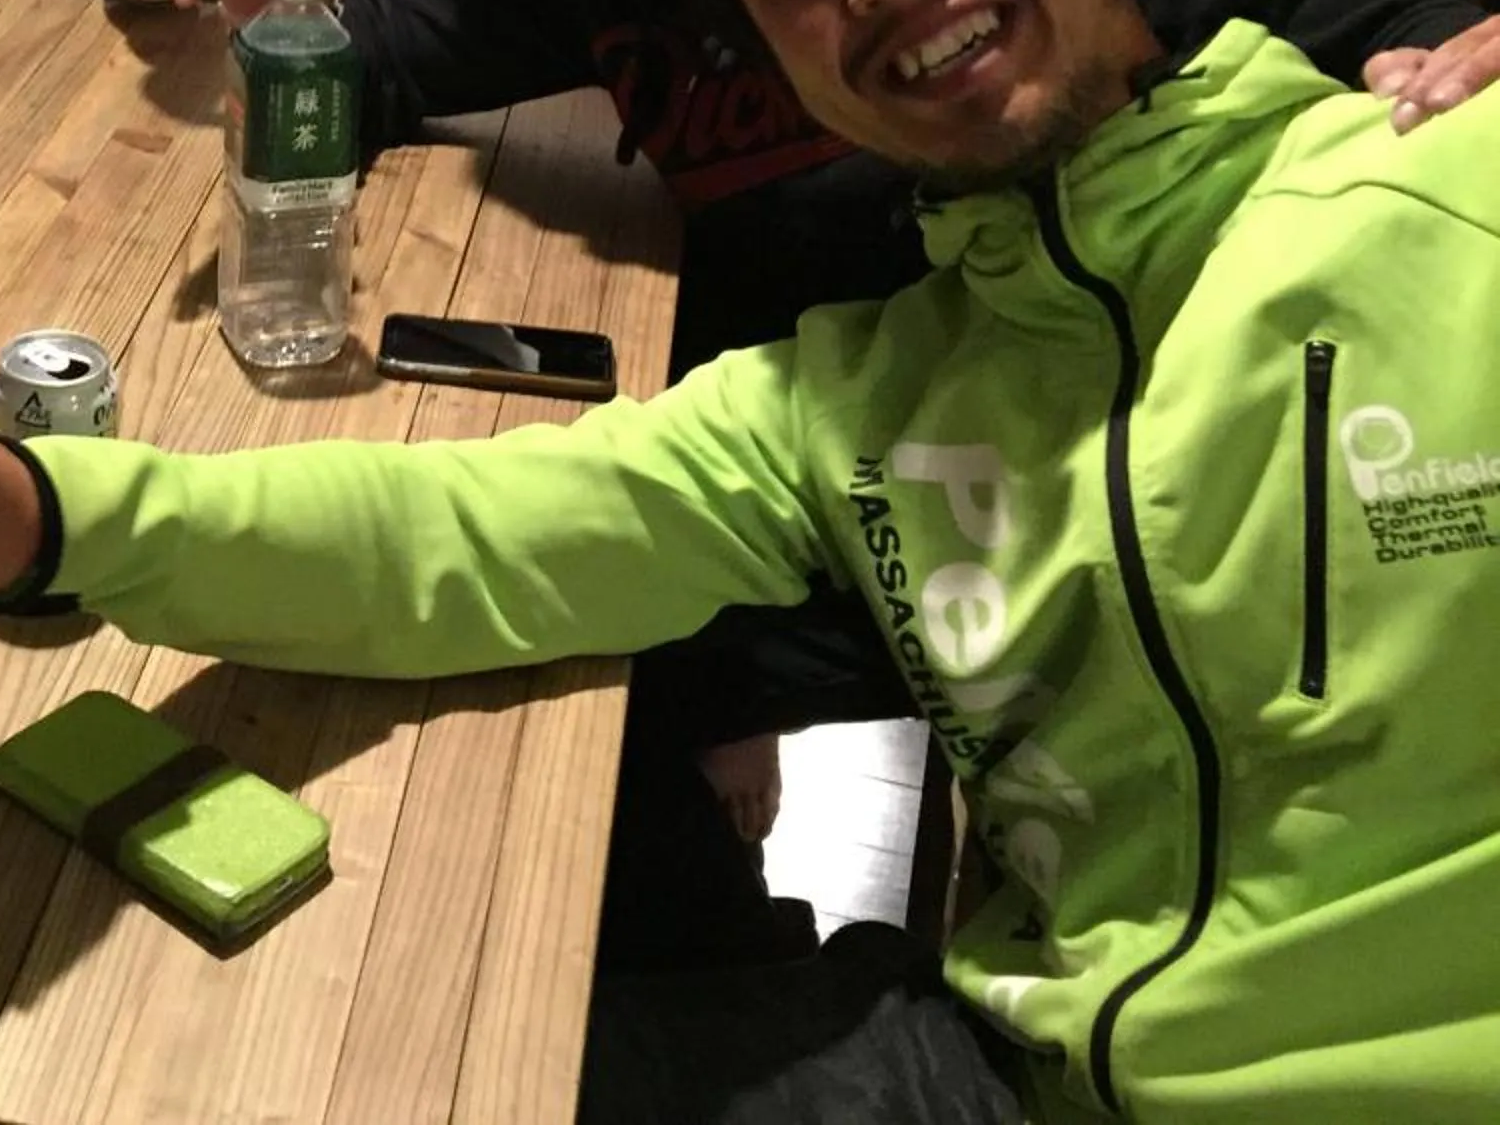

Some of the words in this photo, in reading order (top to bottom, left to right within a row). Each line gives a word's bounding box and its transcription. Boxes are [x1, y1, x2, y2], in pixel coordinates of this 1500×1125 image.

[1363, 483, 1500, 517] High-quali
[1368, 504, 1487, 533] Comfort
[1371, 517, 1487, 548] Thermal
[1375, 532, 1500, 564] Durabilit
[848, 454, 1000, 775] MASSACHUS
